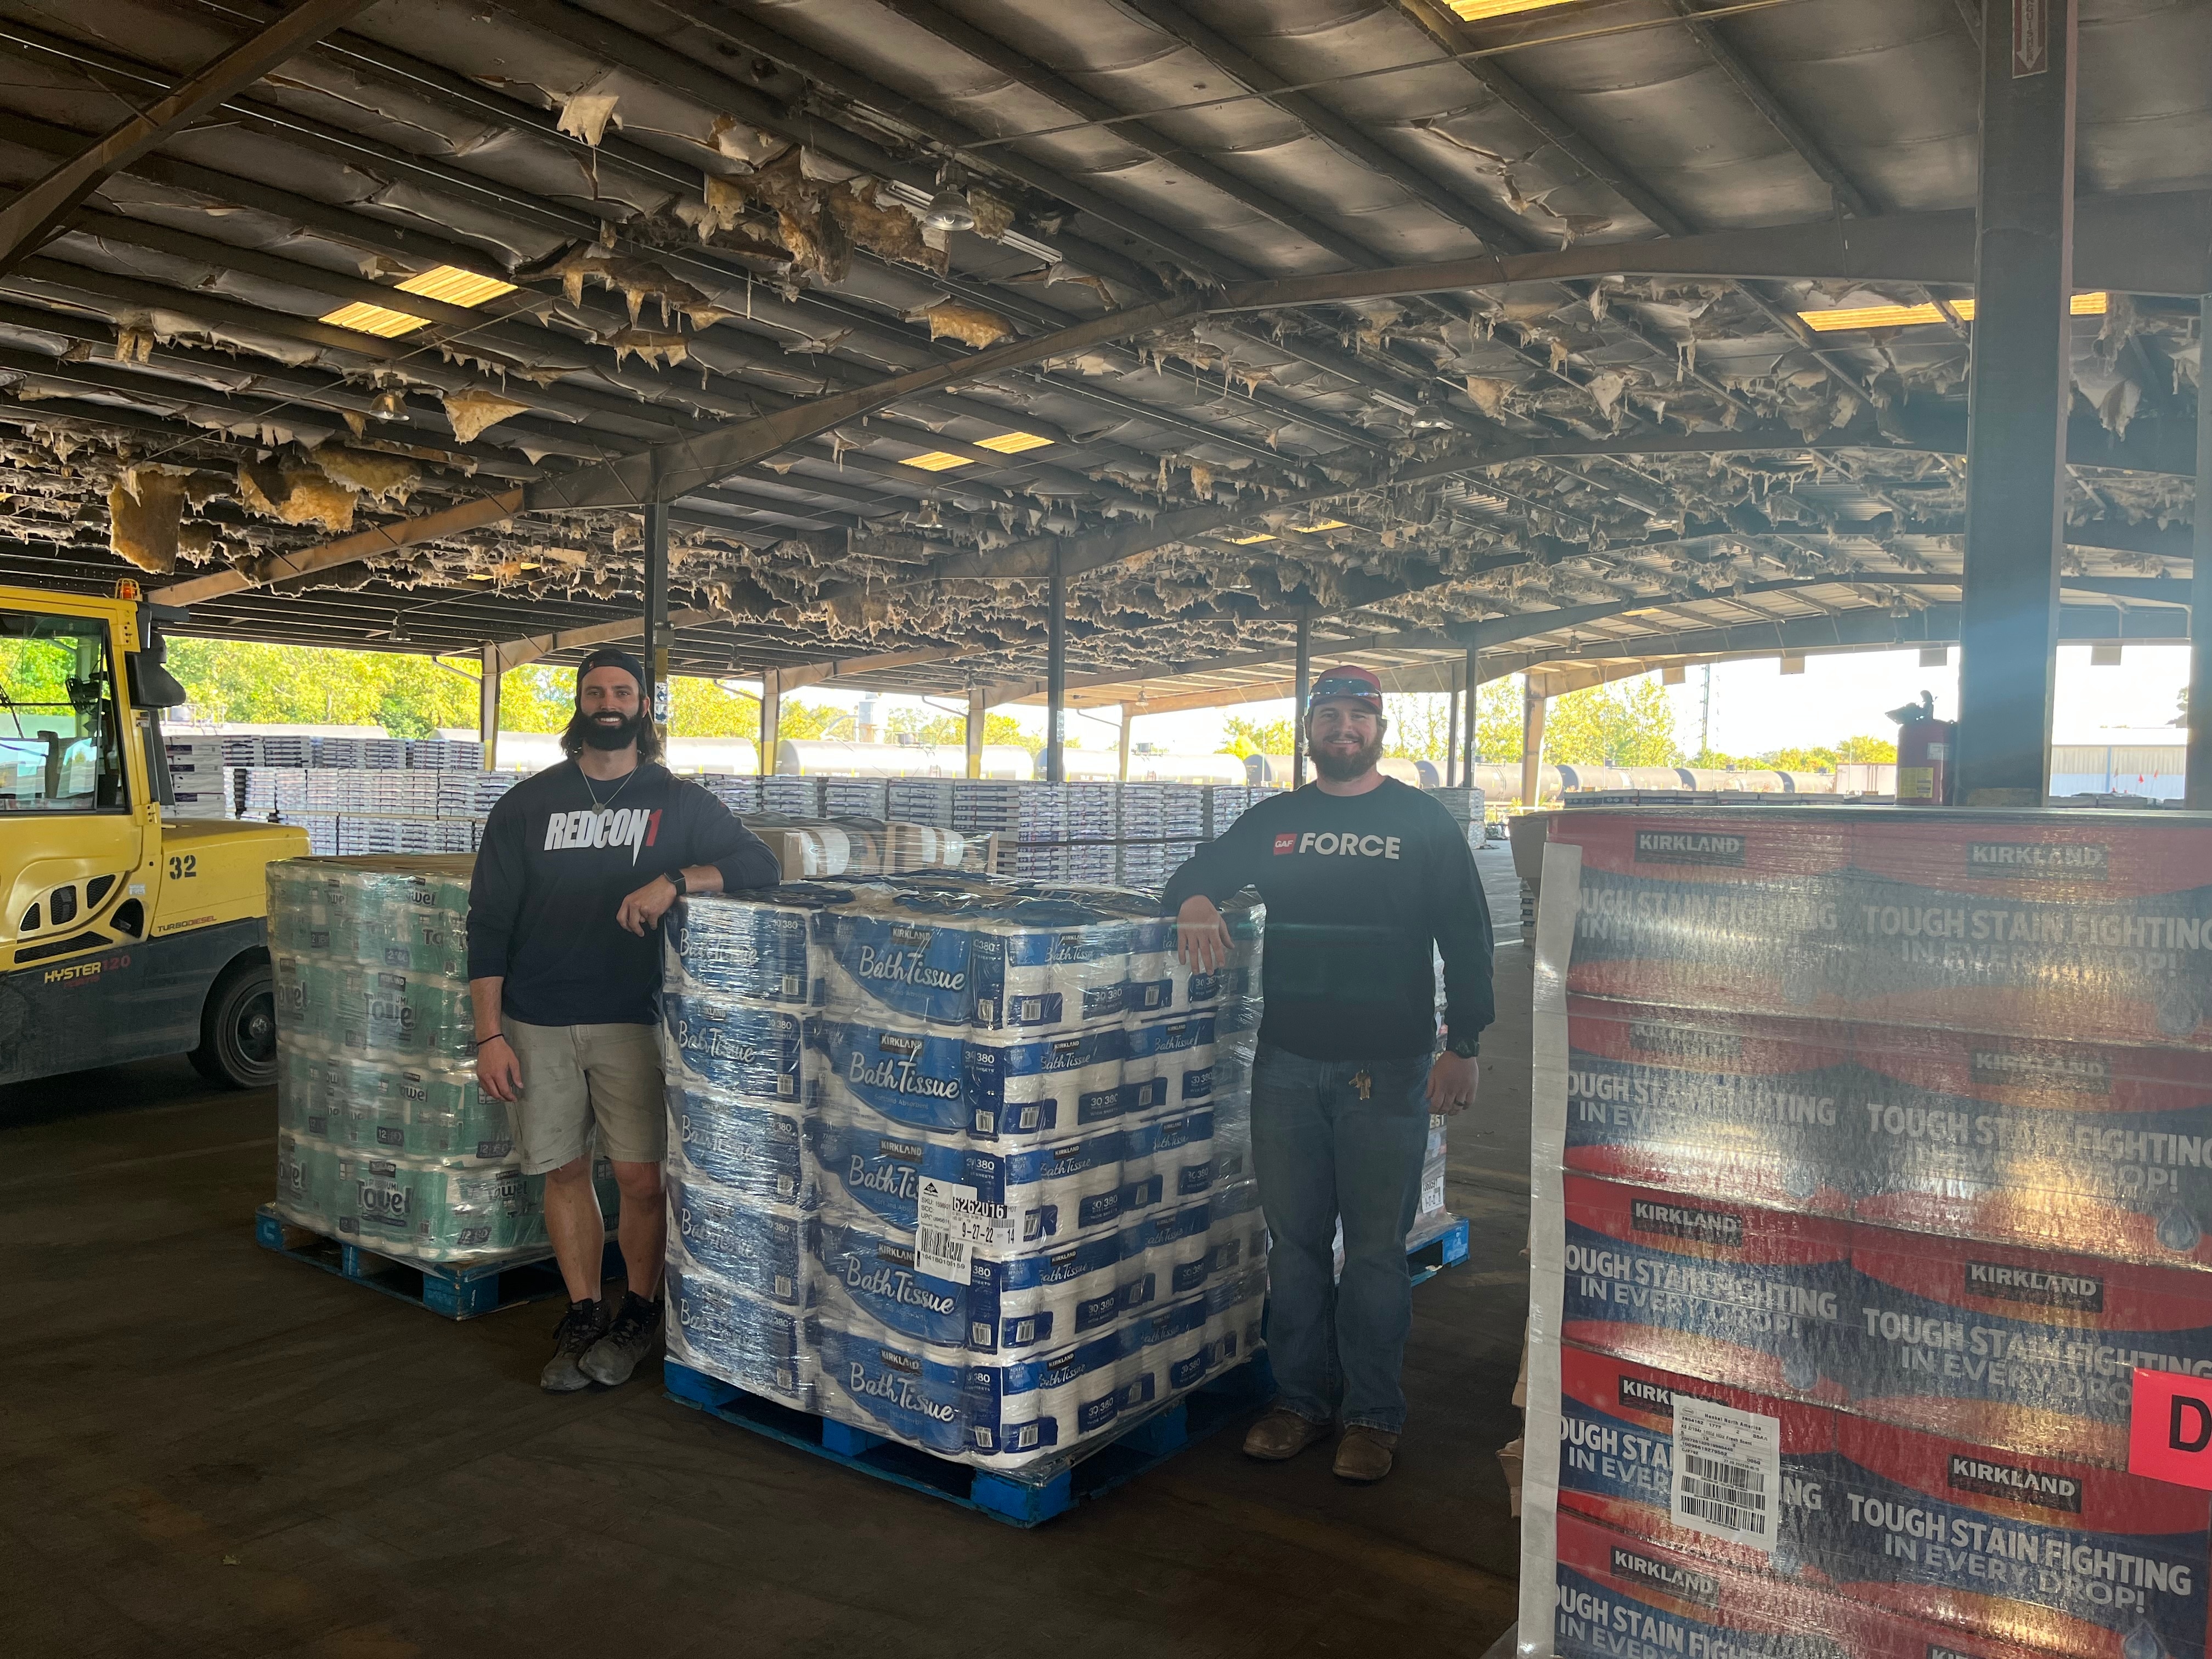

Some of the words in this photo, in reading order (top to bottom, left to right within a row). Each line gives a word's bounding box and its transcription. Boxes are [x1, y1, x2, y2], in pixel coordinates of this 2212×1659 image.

[544, 808, 662, 866] REDCON1
[1640, 834, 1740, 853] KIRKLAND
[1274, 840, 1294, 848] GAF
[1299, 832, 1401, 860] FORCE
[1973, 846, 2101, 864] KIRKLAND
[170, 855, 196, 880] 32
[157, 916, 217, 932] TURBODIESEL
[783, 920, 798, 929] 380
[1863, 906, 1964, 939] TOUGH
[1971, 910, 2062, 943] STAIN
[893, 928, 930, 941] KIRKLAND
[44, 961, 101, 984] HYSTER
[103, 955, 132, 970] 120
[1108, 989, 1122, 1000] 380
[776, 1020, 792, 1030] 380
[881, 1035, 922, 1049] KIRKLAND
[1054, 1041, 1080, 1049] KIRKLAND
[977, 1053, 995, 1064] 380
[1091, 1097, 1102, 1107] 30
[1580, 1101, 1606, 1124] IN
[777, 1121, 792, 1132] 380
[1866, 1103, 1967, 1143] TOUGH
[378, 1130, 387, 1139] 12
[479, 1144, 488, 1153] 12
[881, 1140, 922, 1156] KIRKLAND
[1055, 1146, 1080, 1156] KIRKLAND
[976, 1159, 995, 1171] 380
[1198, 1168, 1209, 1178] 380
[921, 1197, 934, 1206] SKU:
[953, 1198, 1004, 1219] 6262016
[1092, 1200, 1102, 1211] 30
[1103, 1194, 1118, 1207] 380
[1636, 1203, 1735, 1231] KIRKLAND
[462, 1231, 471, 1239] 12
[774, 1223, 790, 1233] 380
[962, 1222, 994, 1244] 9-27-22
[1008, 1228, 1014, 1244] 14
[1052, 1251, 1076, 1262] KIRKLAND
[972, 1265, 991, 1277] 380
[1581, 1276, 1606, 1300] IN
[1971, 1265, 2097, 1296] KIRKLAND
[1088, 1304, 1098, 1314] 30
[1101, 1297, 1114, 1310] 380
[774, 1317, 788, 1328] 380
[1863, 1307, 1964, 1351] TOUGH
[1970, 1326, 2062, 1367] STAIN
[1049, 1353, 1074, 1367] KIRKLAND
[1189, 1358, 1200, 1371] 380
[1902, 1346, 1933, 1372] IN
[1088, 1406, 1098, 1416] 30
[1100, 1397, 1114, 1410] 380
[1740, 1423, 1761, 1431] America
[1569, 1447, 1595, 1472] IN
[1954, 1458, 2075, 1497] KIRKLAND
[1847, 1493, 1945, 1542] TOUGH
[1951, 1519, 2039, 1566] STAIN
[2046, 1538, 2191, 1596] FIGHTING
[1616, 1551, 1713, 1594] KIRKLAND
[1886, 1533, 1916, 1561] IN
[1926, 1544, 2029, 1586] EVERY
[2040, 1570, 2146, 1613] DROP!
[1561, 1615, 1585, 1641] IN
[1613, 1606, 1684, 1653] STAIN
